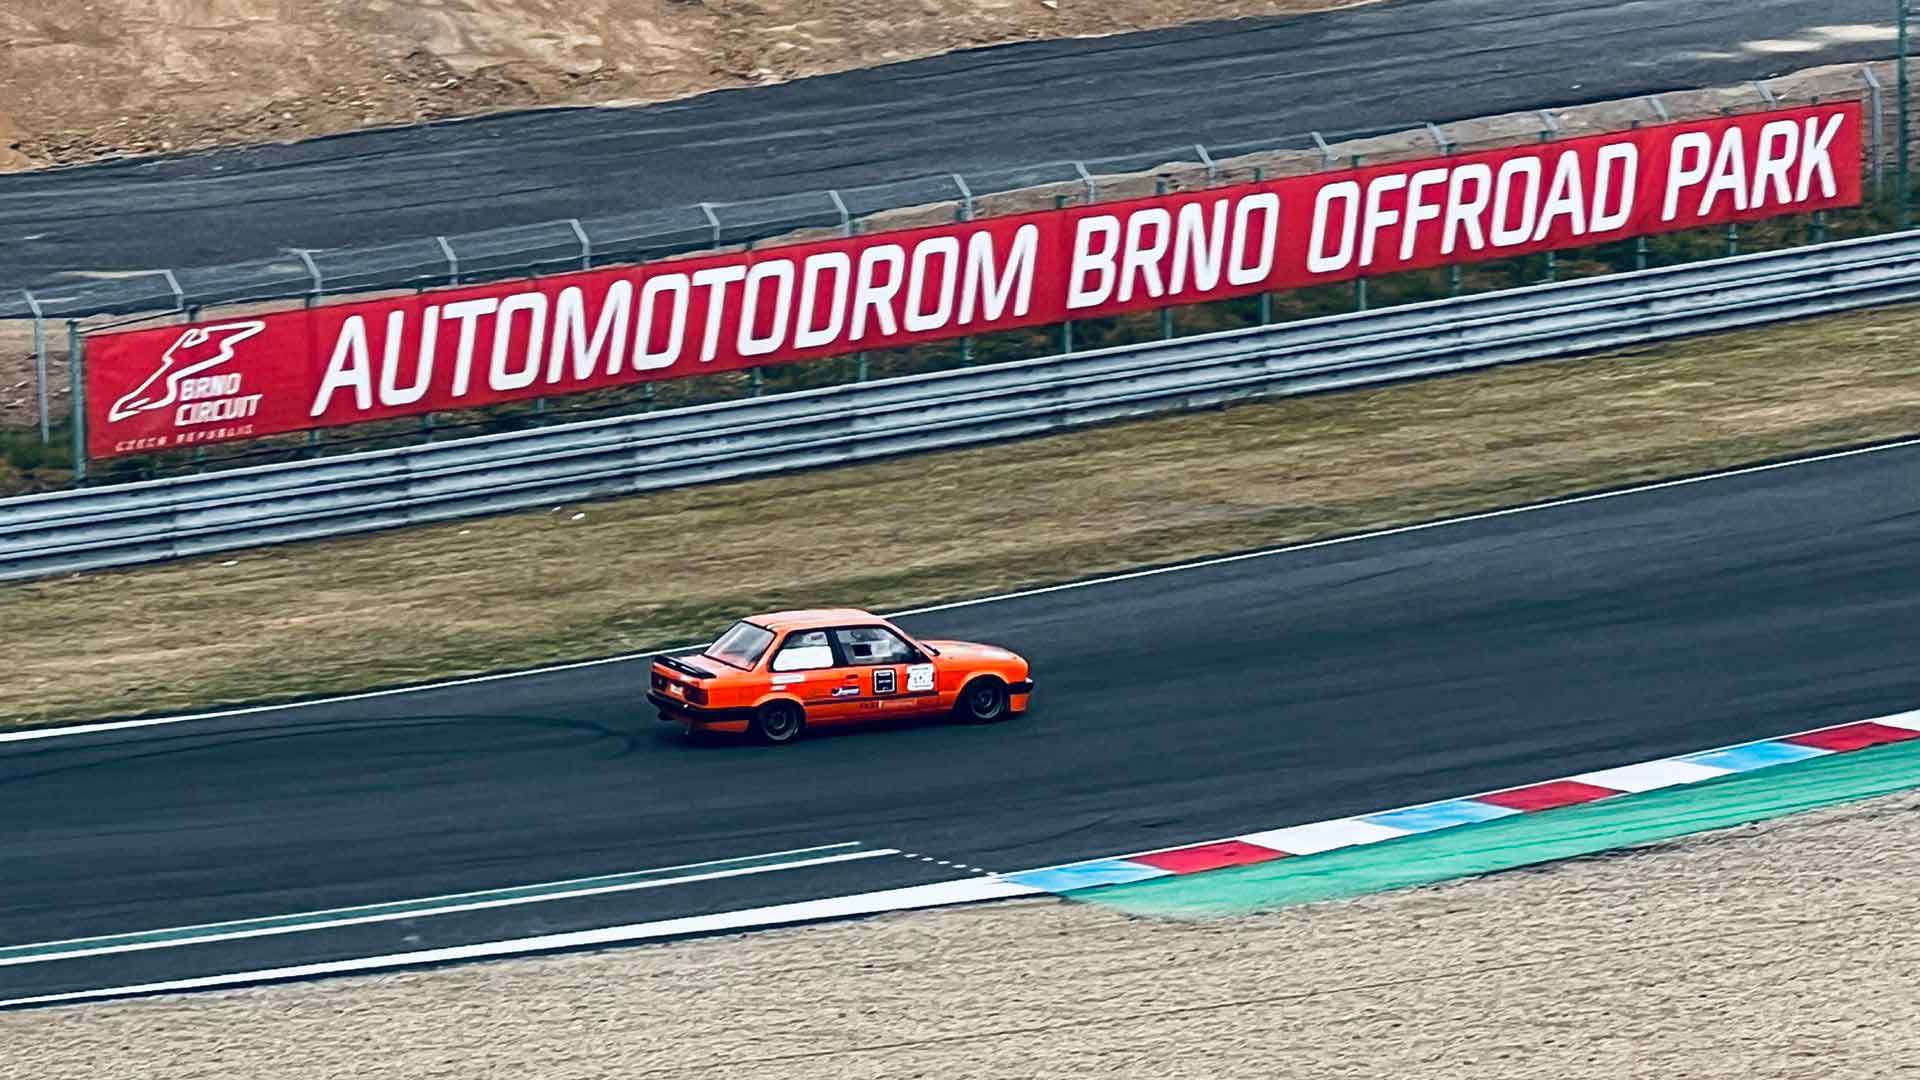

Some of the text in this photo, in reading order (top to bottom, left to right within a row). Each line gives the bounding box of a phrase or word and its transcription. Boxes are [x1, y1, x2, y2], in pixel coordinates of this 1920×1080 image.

[311, 112, 1846, 417] AUTOMOTODROM BRNO OFFROAD PARK
[180, 373, 242, 401] BRNO
[174, 394, 263, 426] CIRCUIT
